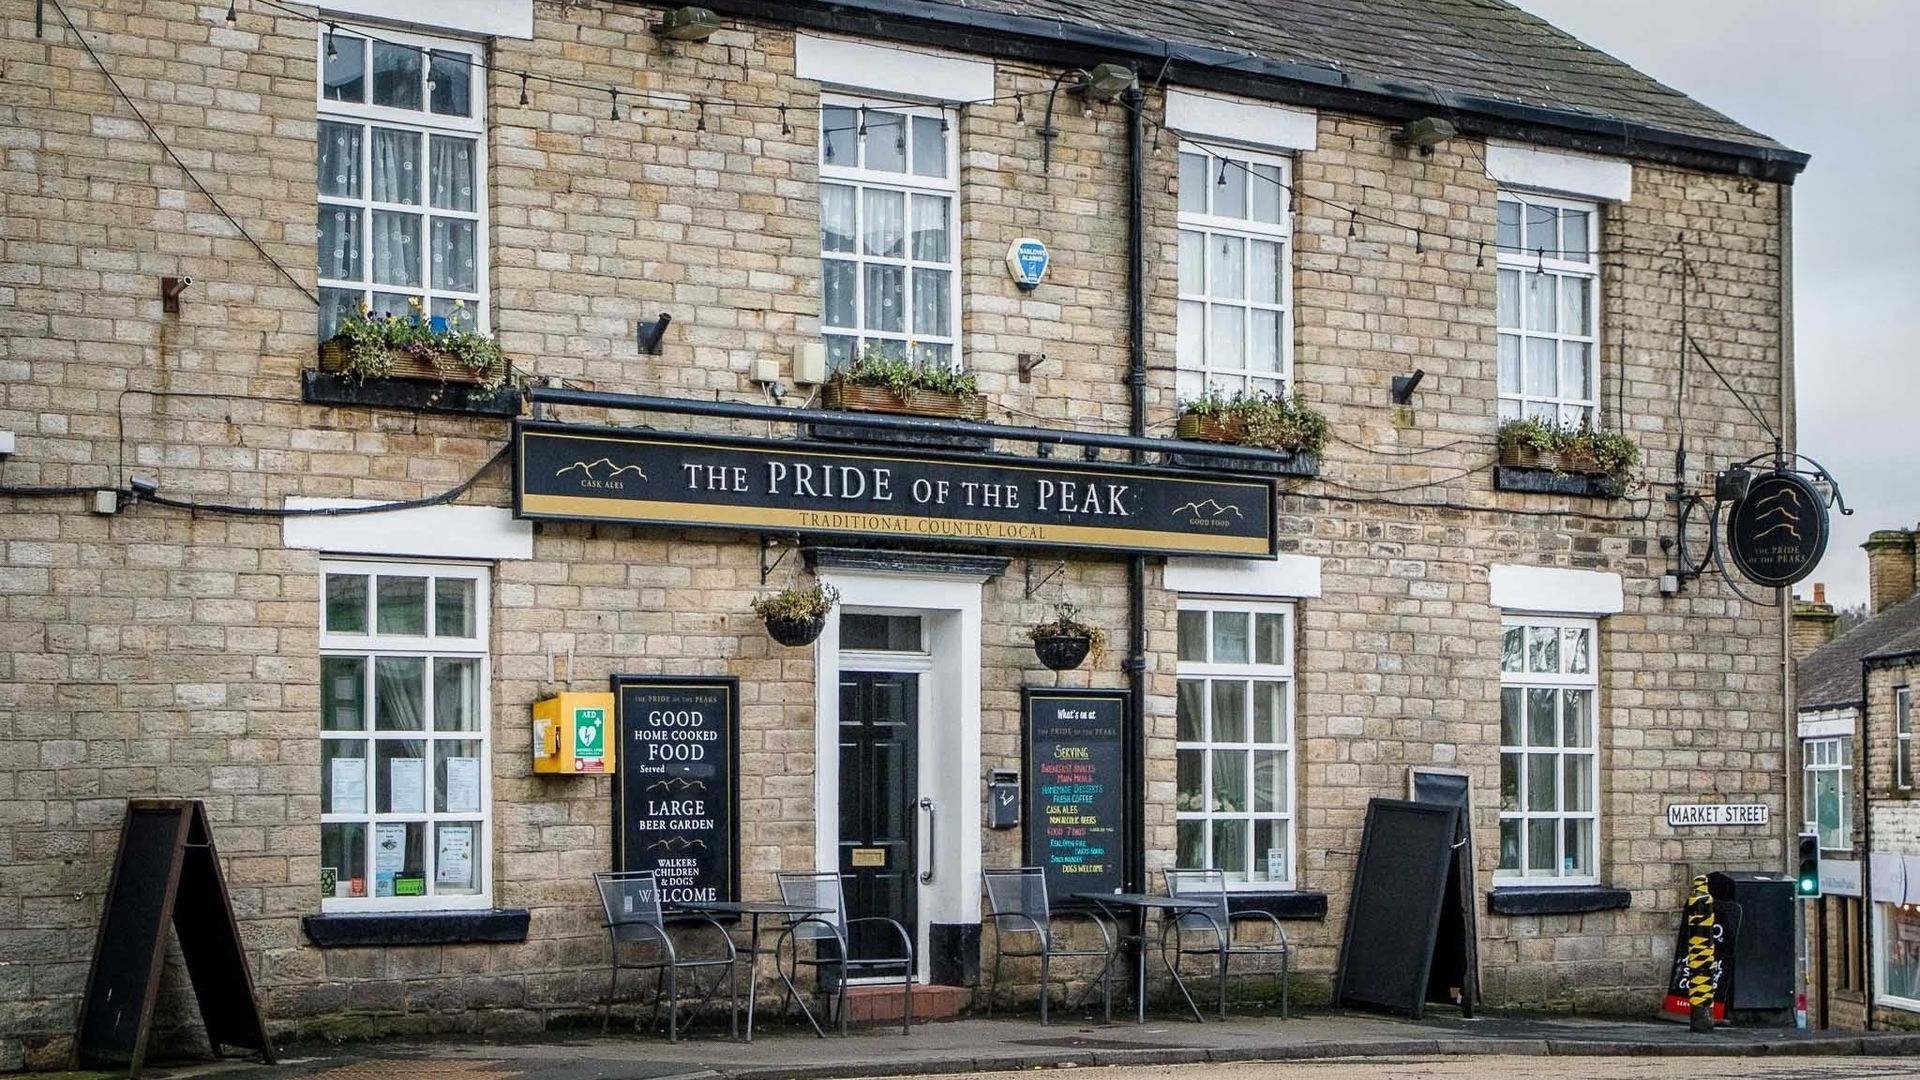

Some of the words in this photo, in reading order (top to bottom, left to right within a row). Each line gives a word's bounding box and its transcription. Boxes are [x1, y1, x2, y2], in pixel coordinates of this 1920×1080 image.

[580, 479, 602, 489] CASK
[604, 480, 624, 490] ALES
[683, 463, 749, 492] THE
[768, 461, 893, 501] PRIDE
[913, 478, 950, 504] OF
[960, 481, 1020, 510] THE
[1037, 480, 1130, 516] PEAK
[800, 512, 912, 532] TRADITIONAL
[917, 518, 992, 538] COUNTRY
[999, 524, 1046, 540] LOCAL
[1189, 518, 1209, 527] GOOD
[1211, 519, 1230, 528] FOOD
[1772, 545, 1800, 554] PRIDE
[1777, 554, 1806, 563] PEAKS
[648, 695, 670, 703] PRIDE
[695, 695, 718, 704] PEAKS
[649, 711, 703, 727] GOOD
[1057, 708, 1079, 720] What's
[634, 730, 668, 741] HOME
[671, 730, 718, 741] COOKED
[648, 744, 704, 760] FOOD
[1054, 745, 1089, 758] SERVING
[640, 764, 665, 773] Served
[1072, 794, 1094, 803] COFFEE
[648, 800, 705, 816] LARGE
[1046, 805, 1062, 814] CASK
[1062, 805, 1078, 814] ALES
[1671, 807, 1720, 823] MARKET
[1725, 806, 1766, 822] STREET
[640, 820, 666, 830] BEER
[670, 819, 714, 830] GARDEN
[658, 859, 697, 867] WALKERS
[655, 868, 700, 877] CHILDREN
[1062, 864, 1077, 873] DOGS
[1077, 864, 1104, 873] WELCOME
[661, 878, 668, 886] &
[670, 877, 694, 886] DOGS
